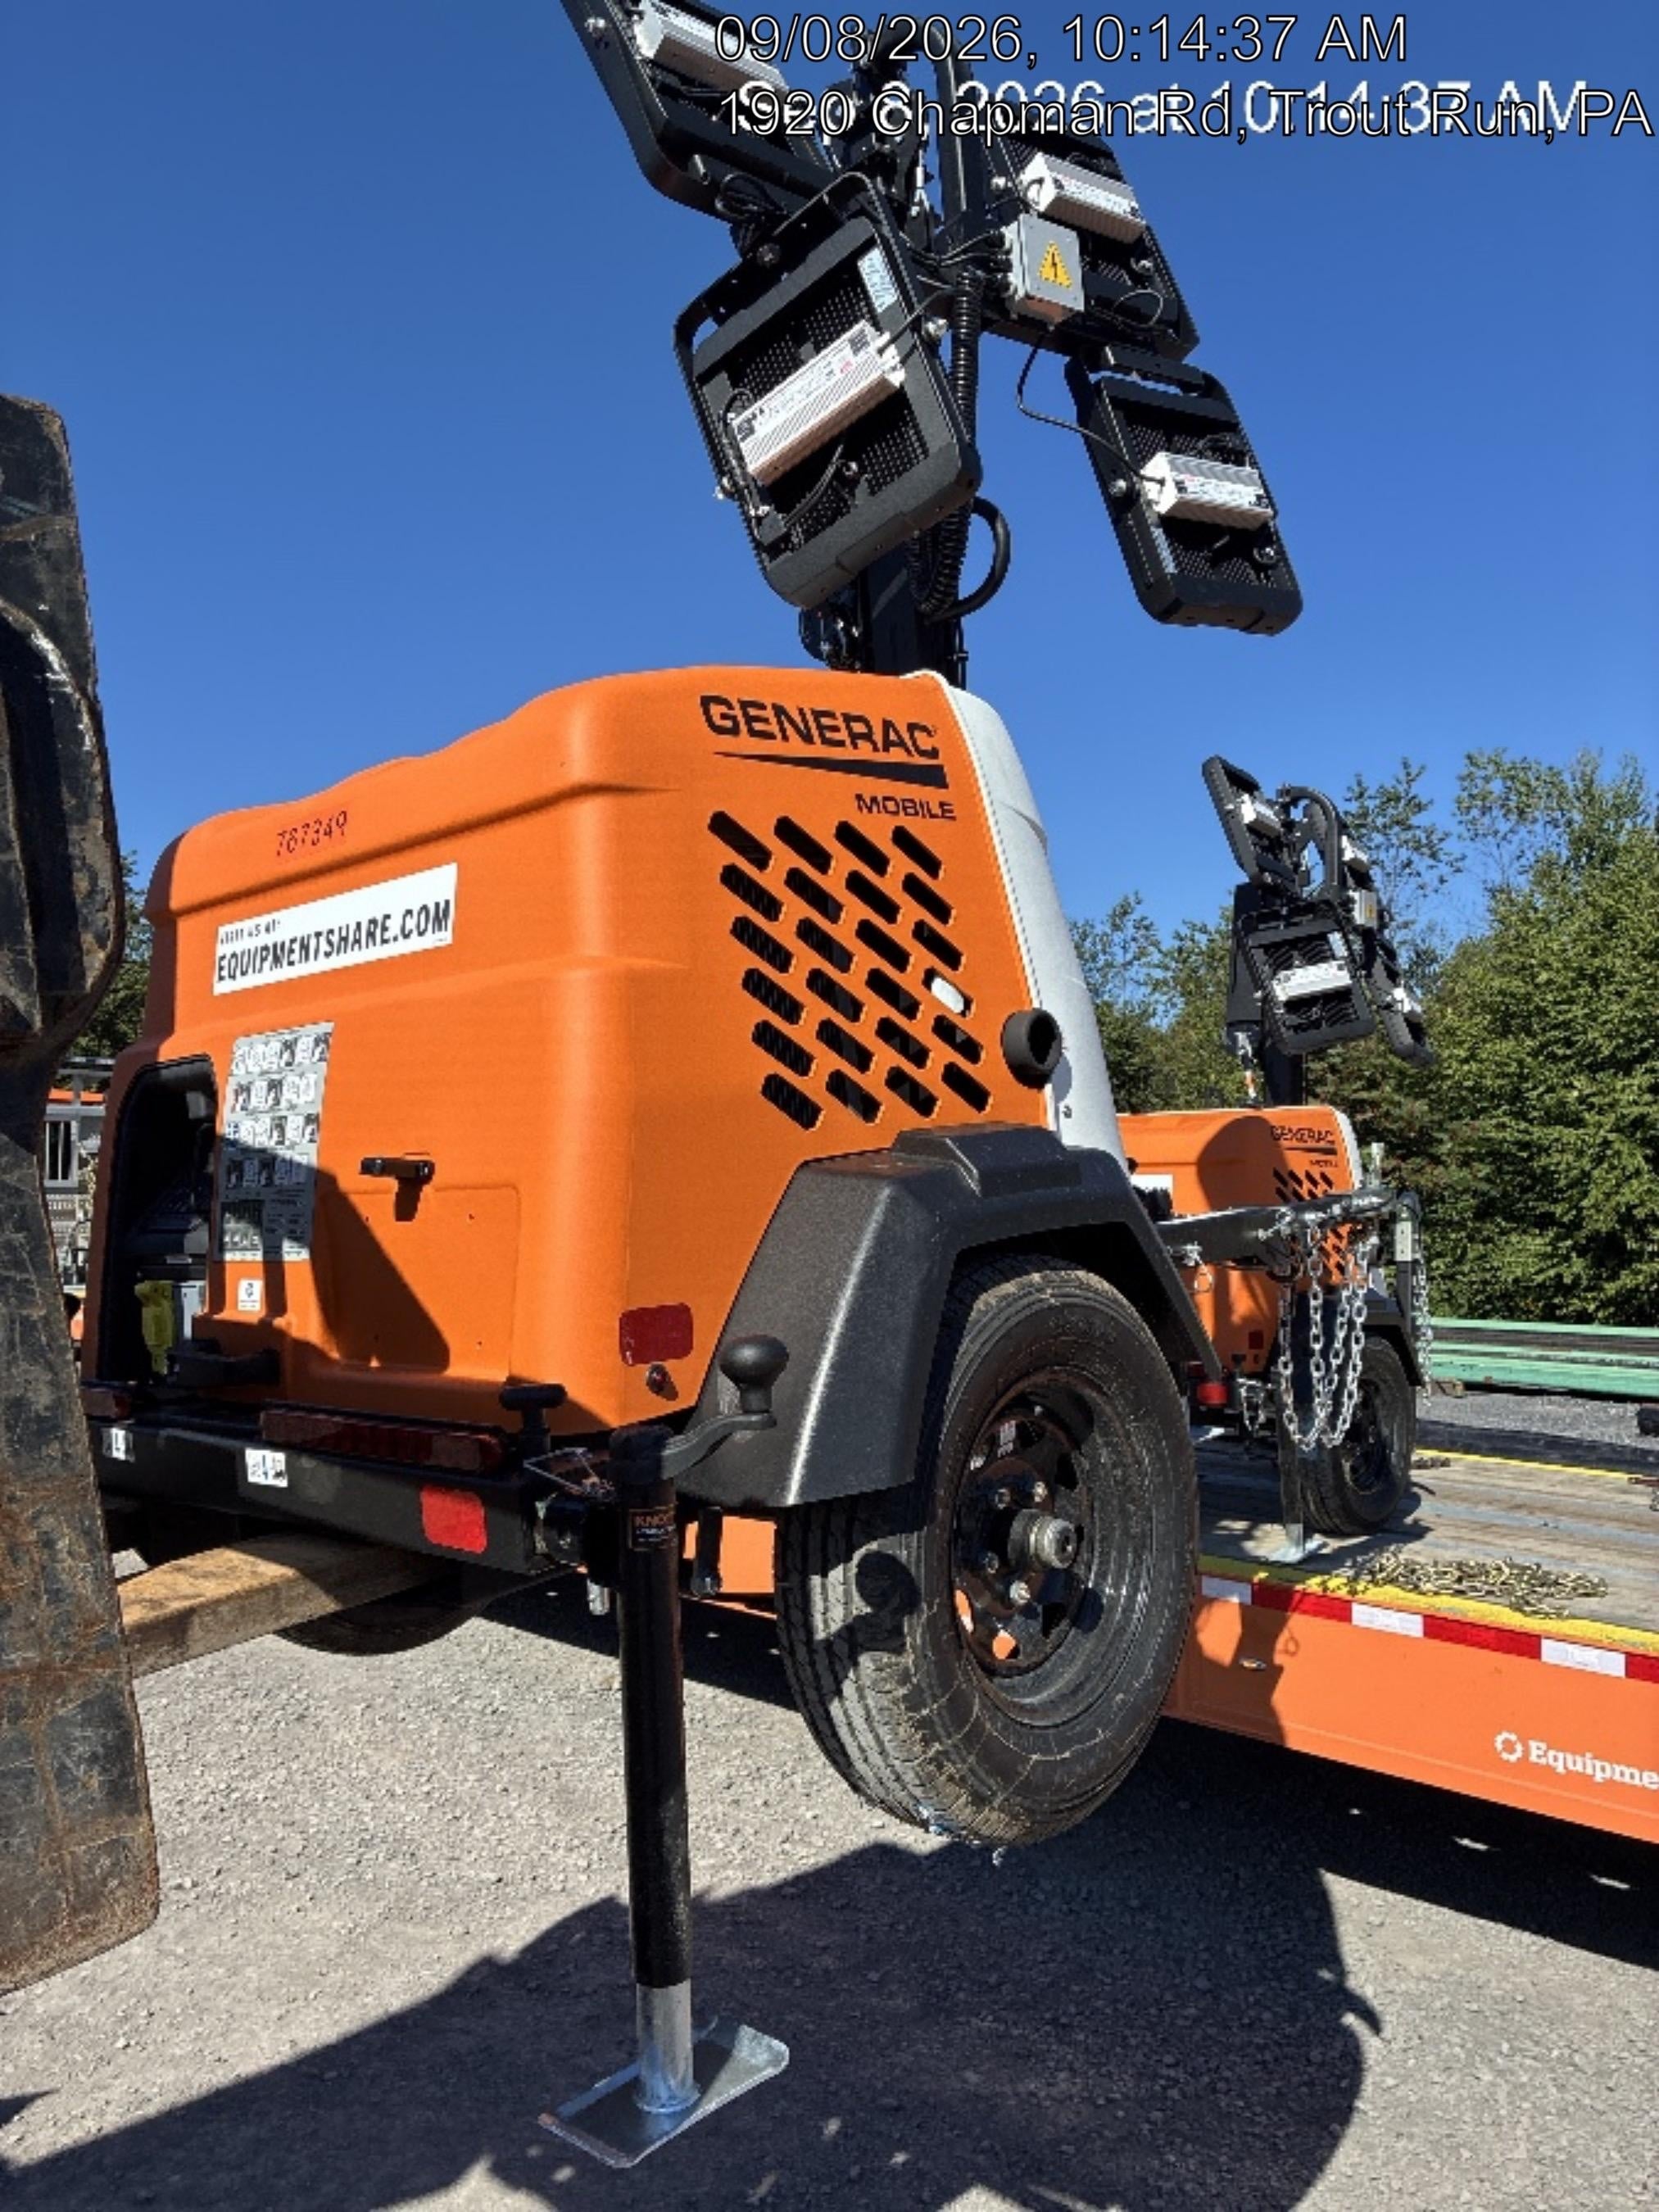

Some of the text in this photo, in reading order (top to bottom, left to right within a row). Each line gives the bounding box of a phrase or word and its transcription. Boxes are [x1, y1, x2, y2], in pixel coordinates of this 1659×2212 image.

[700, 694, 941, 760] GENERAC
[854, 793, 957, 820] MOBILE
[216, 899, 451, 983] EQUIPMENTSHARE.COM
[1527, 1738, 1659, 1790] Equipme
